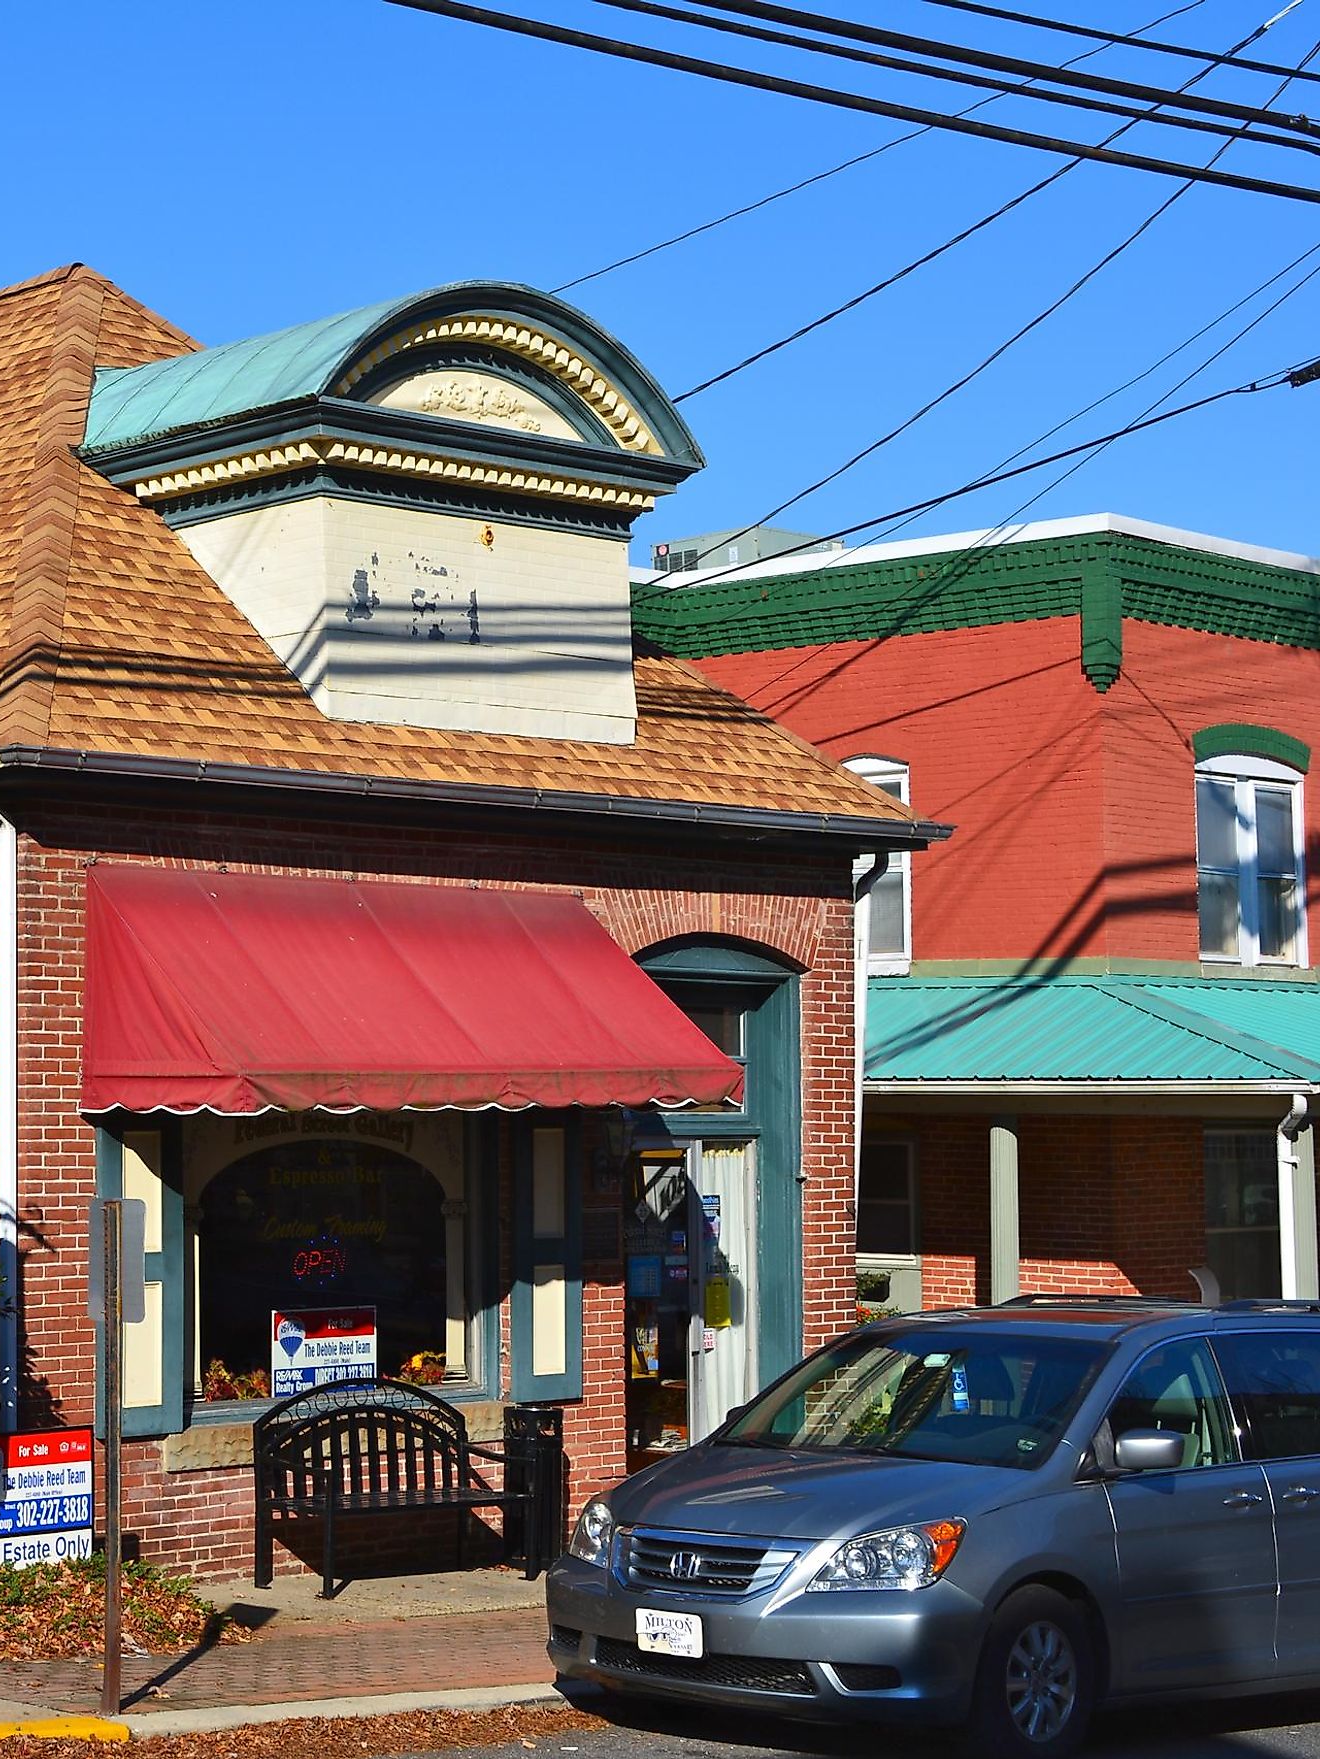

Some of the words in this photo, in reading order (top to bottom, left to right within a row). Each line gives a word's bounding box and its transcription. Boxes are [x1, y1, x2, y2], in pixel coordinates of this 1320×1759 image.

[292, 1249, 347, 1276] OPEN
[304, 1343, 315, 1357] The
[317, 1342, 337, 1357] Debbie
[339, 1341, 354, 1355] Reed
[355, 1340, 371, 1354] Team
[275, 1382, 294, 1395] Realty
[18, 1445, 30, 1457] For
[33, 1444, 48, 1457] Sale
[2, 1473, 16, 1491] The
[18, 1471, 45, 1489] Debbie
[46, 1469, 65, 1487] Reed
[67, 1468, 86, 1485] Team
[16, 1496, 89, 1528] 302-227-3818
[4, 1540, 51, 1562] Estate
[56, 1535, 90, 1560] Only
[645, 1616, 693, 1635] MILTON
